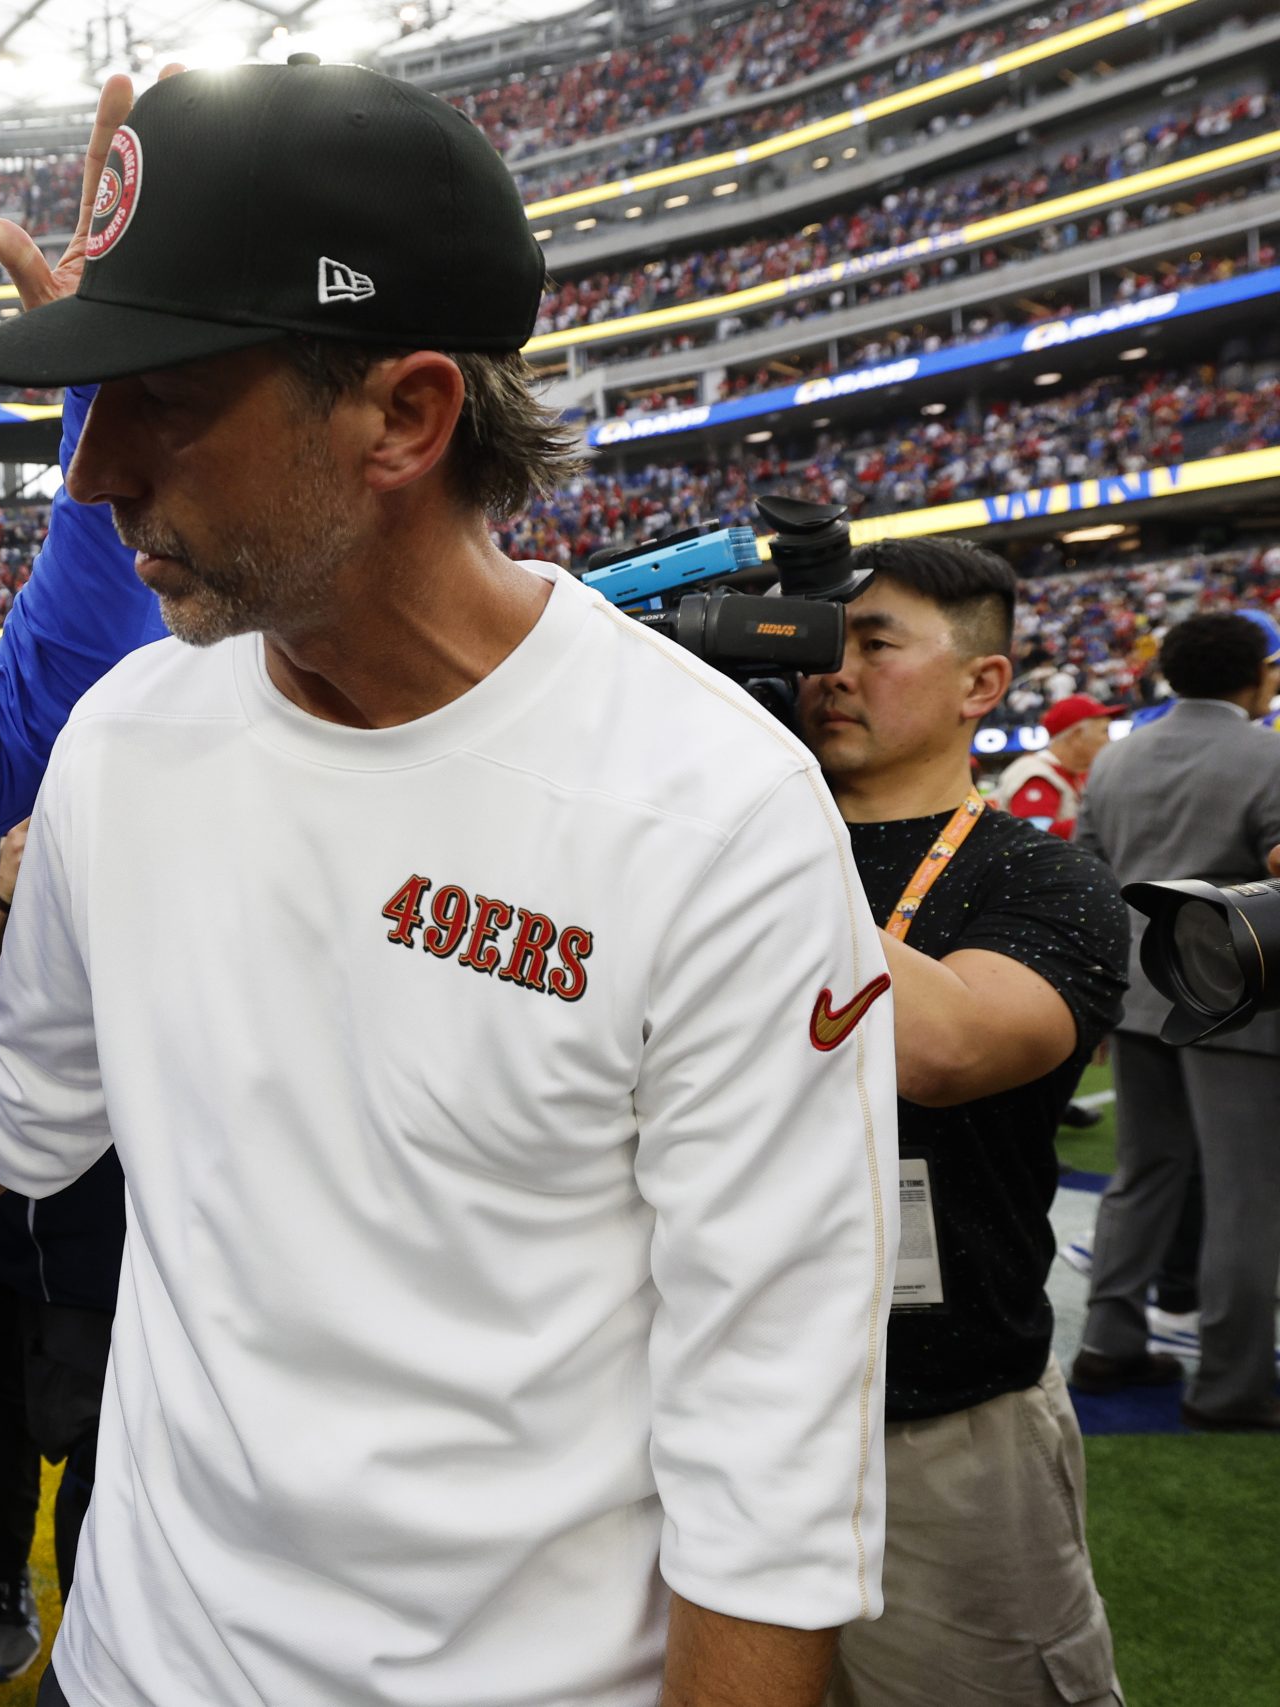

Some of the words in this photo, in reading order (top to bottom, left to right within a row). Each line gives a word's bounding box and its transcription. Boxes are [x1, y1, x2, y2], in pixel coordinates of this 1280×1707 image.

[104, 206, 127, 241] 49ERS
[639, 613, 666, 622] SONY
[756, 622, 798, 637] HDVS
[381, 874, 594, 1002] 49ERS
